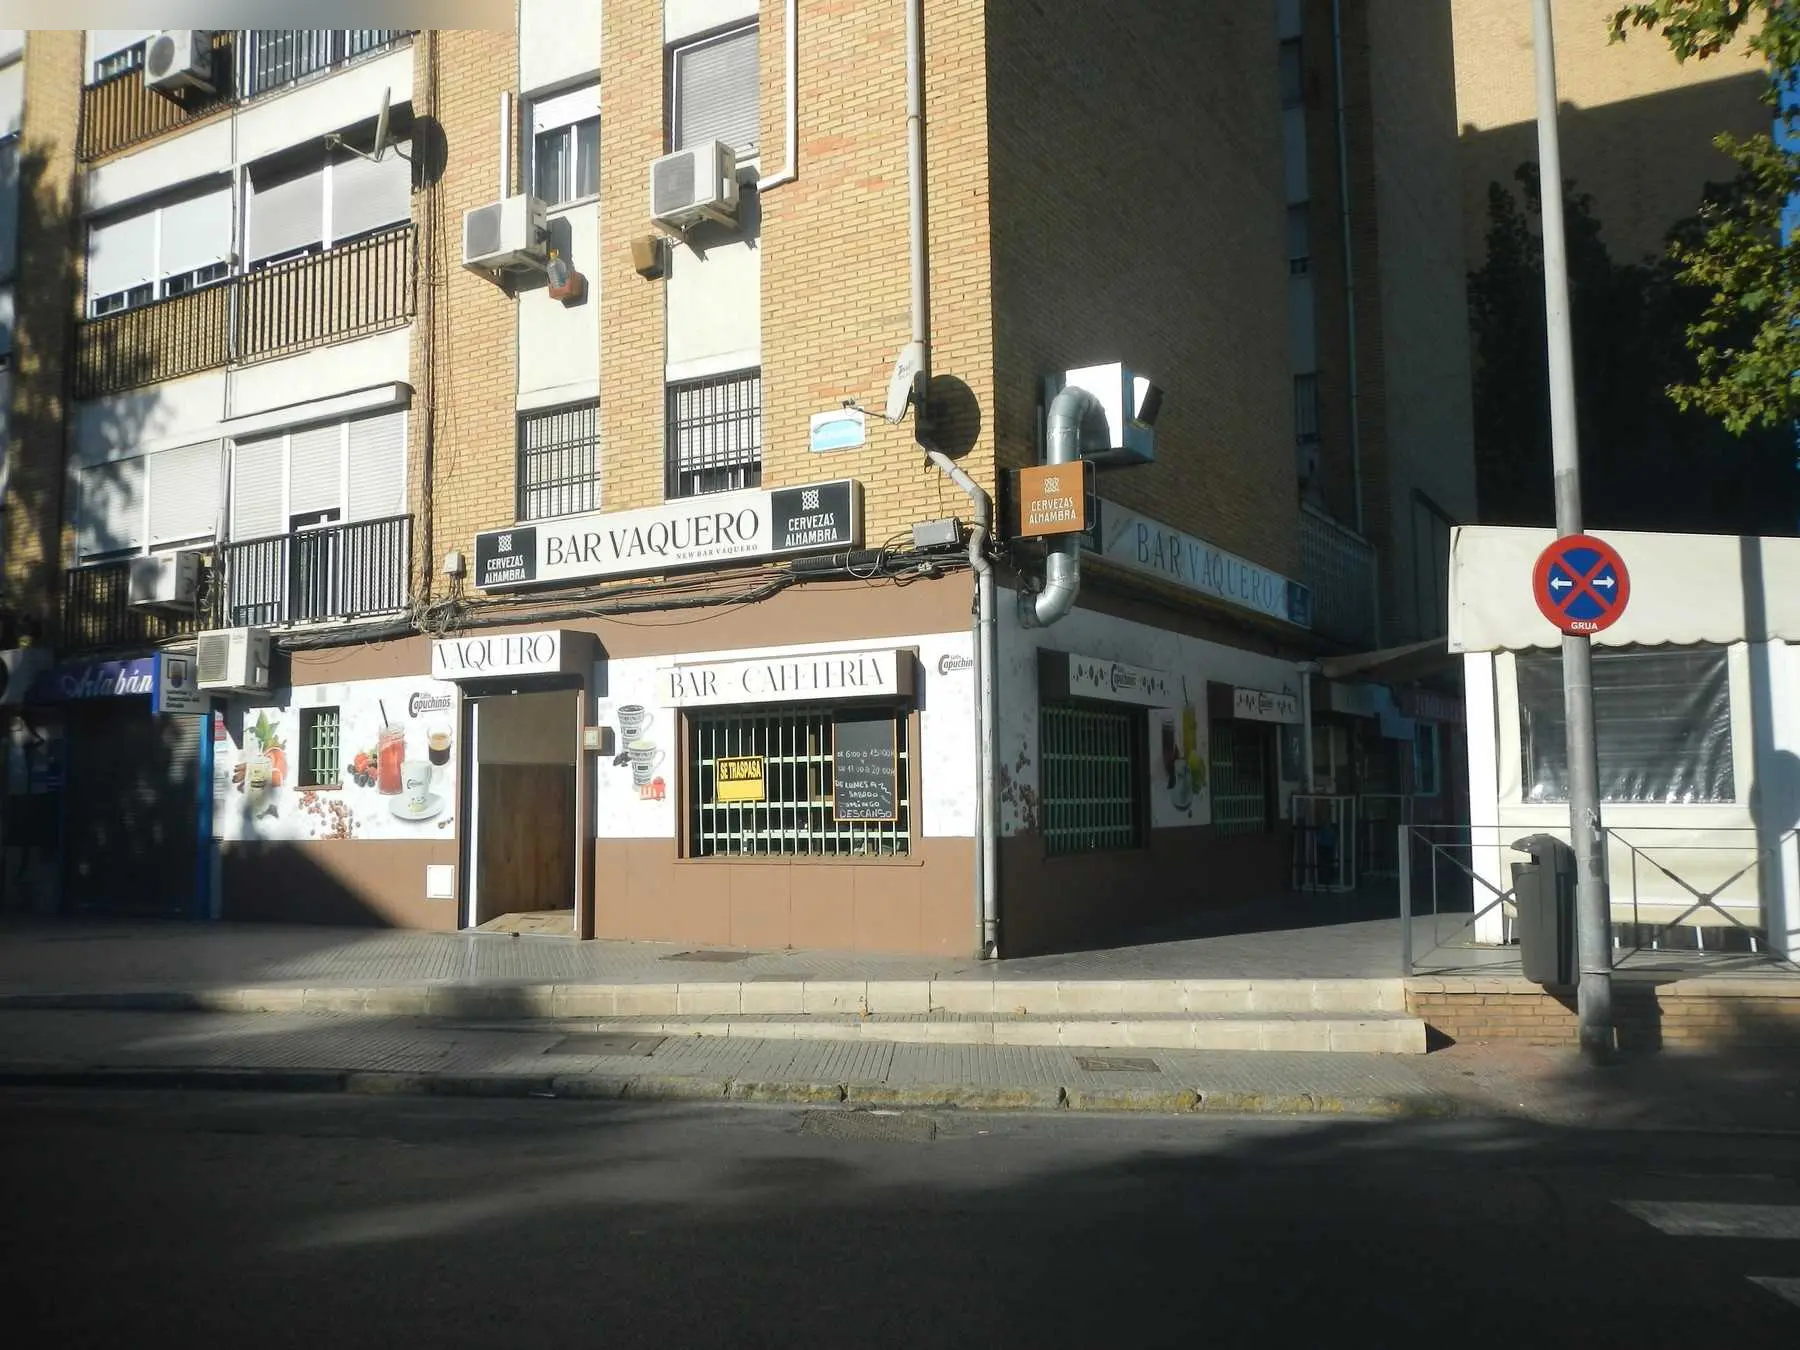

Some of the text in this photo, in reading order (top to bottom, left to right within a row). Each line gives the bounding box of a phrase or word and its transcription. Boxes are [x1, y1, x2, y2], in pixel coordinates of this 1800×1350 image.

[1031, 497, 1073, 512] CERVEZAS
[788, 512, 835, 531] CERVEZAS
[1029, 509, 1076, 524] ALHAMBRA
[545, 509, 760, 566] BAR VAQUERO
[785, 528, 838, 547] ALHAMBRA
[676, 544, 758, 560] NEW BAR VAQUERO
[487, 555, 524, 571] CERVEZAS
[1136, 522, 1273, 609] BAR VAQUERO
[484, 570, 526, 585] ALHAMBRA
[1570, 621, 1599, 630] GRUA
[438, 634, 556, 671] VAQUERO
[938, 654, 974, 676] Capuchin
[669, 670, 718, 698] BAR
[742, 653, 885, 694] CAFETERÍA
[720, 760, 762, 780] SE TRASPASA
[839, 808, 892, 818] DESCANSO
